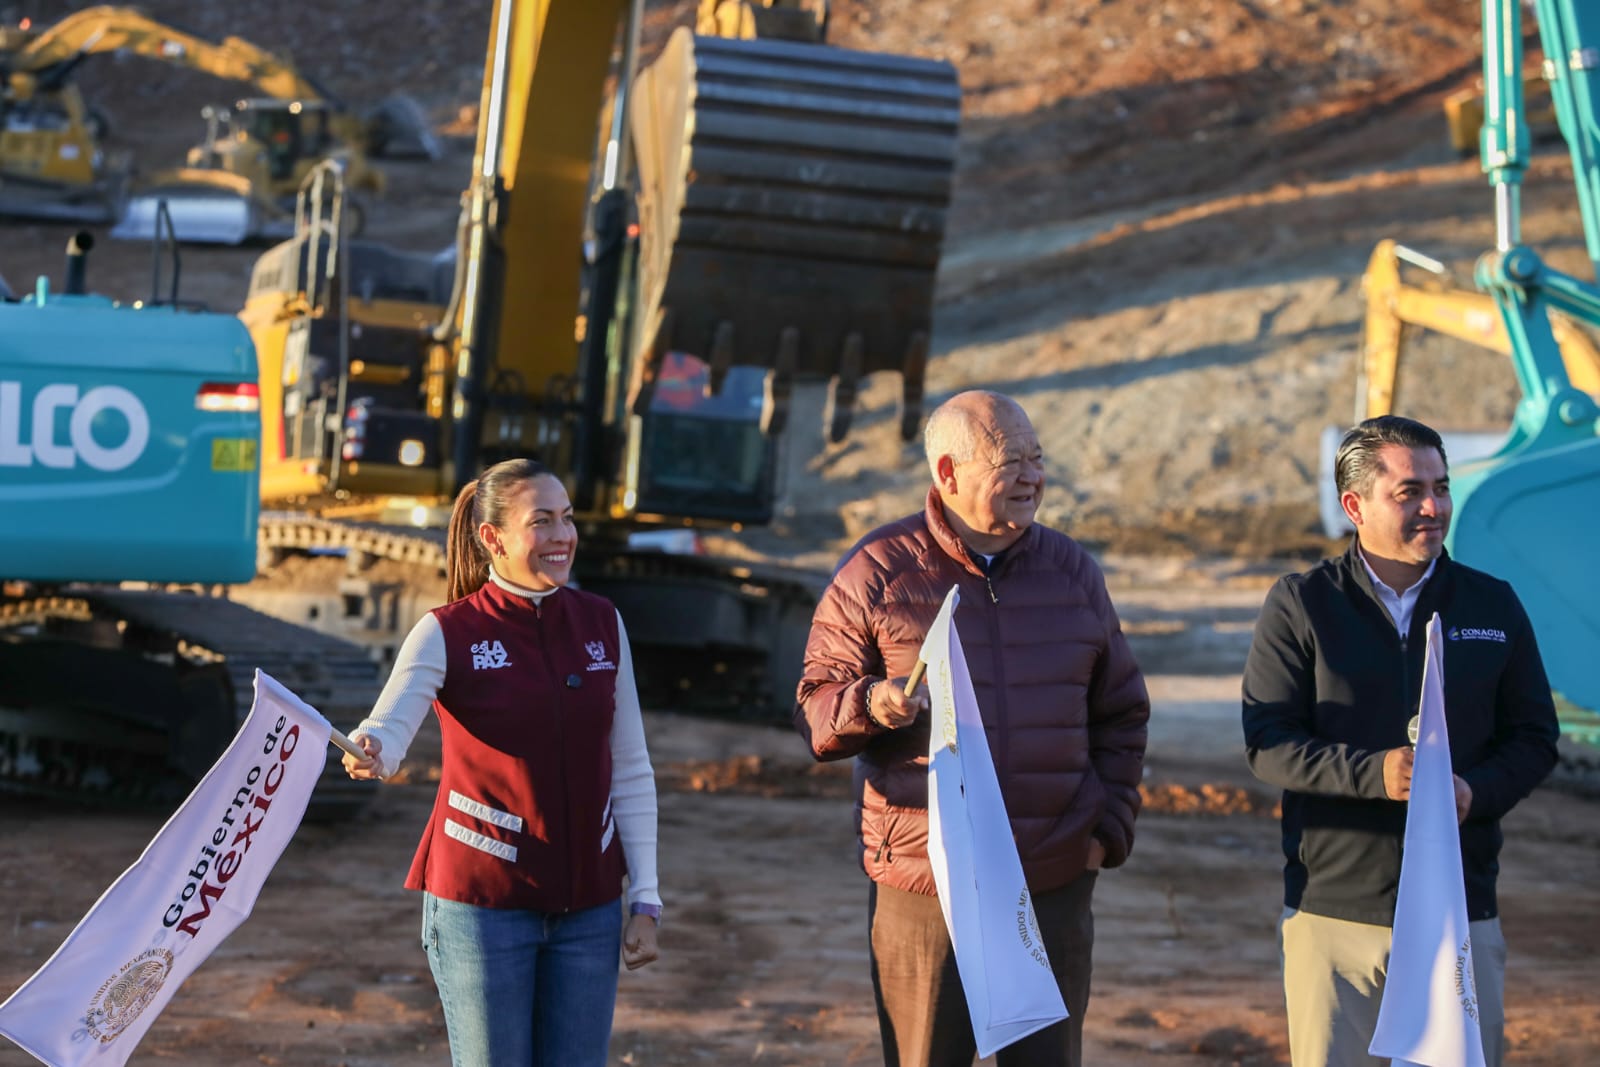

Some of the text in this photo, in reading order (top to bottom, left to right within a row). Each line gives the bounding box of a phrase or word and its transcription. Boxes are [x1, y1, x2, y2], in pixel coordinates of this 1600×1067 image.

[1461, 628, 1507, 639] CONAGUA
[162, 715, 287, 929] Gobierno de
[175, 724, 300, 939] México
[1017, 910, 1033, 949] UNIDOS
[90, 973, 118, 1005] UNIDOS
[1455, 955, 1466, 996] UNIDOS
